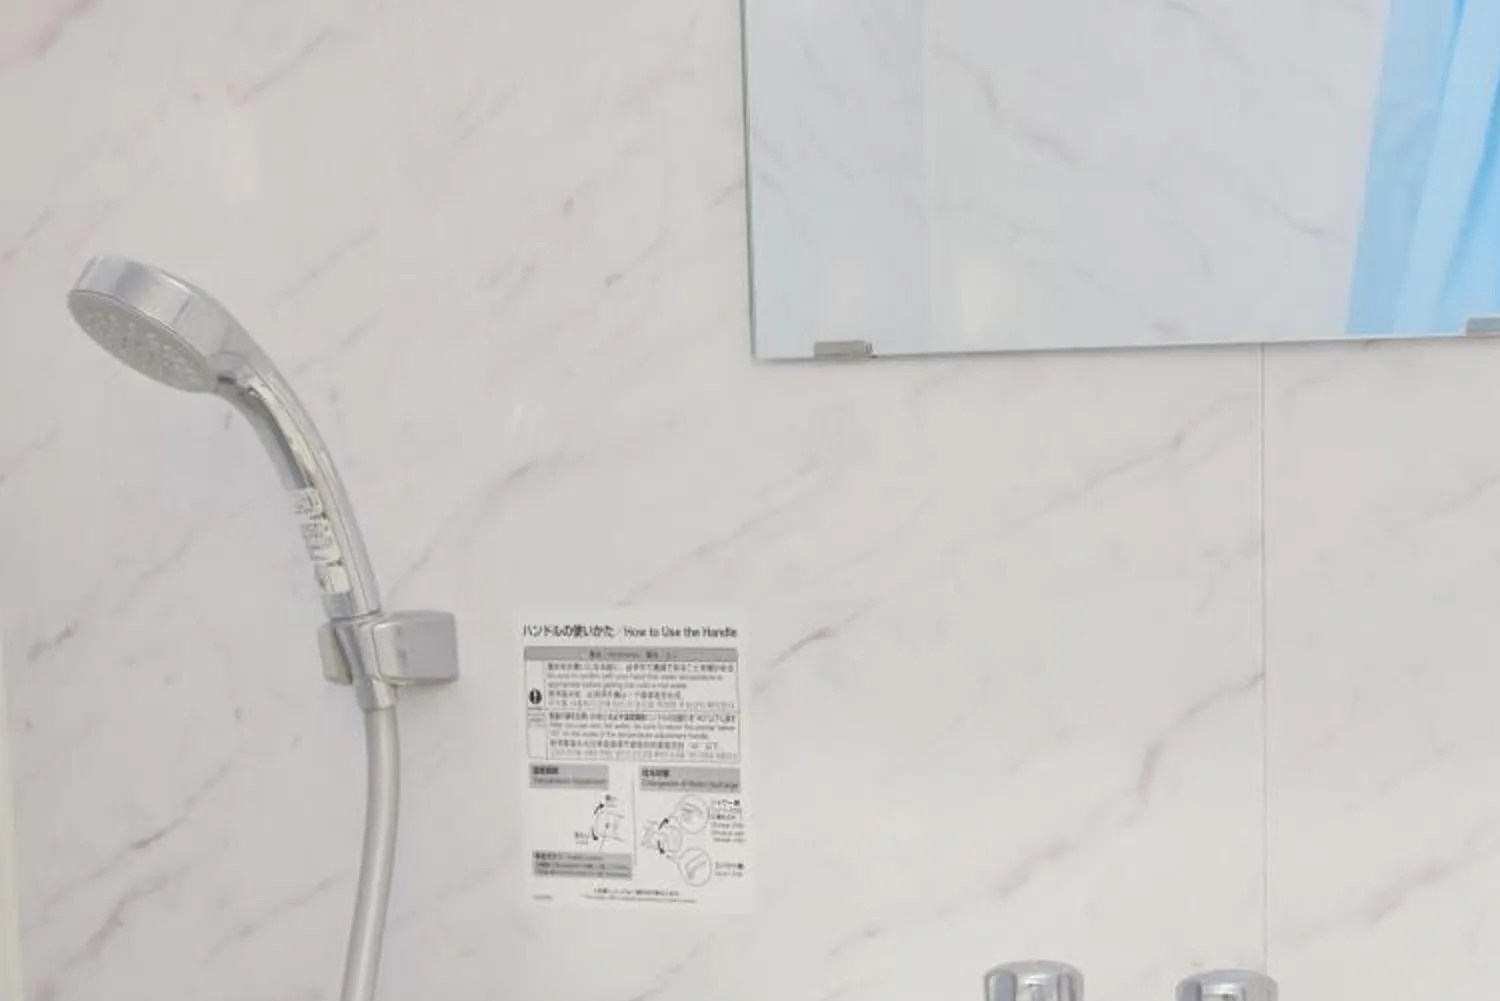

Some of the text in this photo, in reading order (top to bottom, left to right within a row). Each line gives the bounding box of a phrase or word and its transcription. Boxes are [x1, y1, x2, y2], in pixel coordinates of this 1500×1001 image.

[649, 625, 660, 637] to
[661, 625, 681, 637] Use
[683, 625, 700, 637] the
[702, 625, 737, 638] Handle
